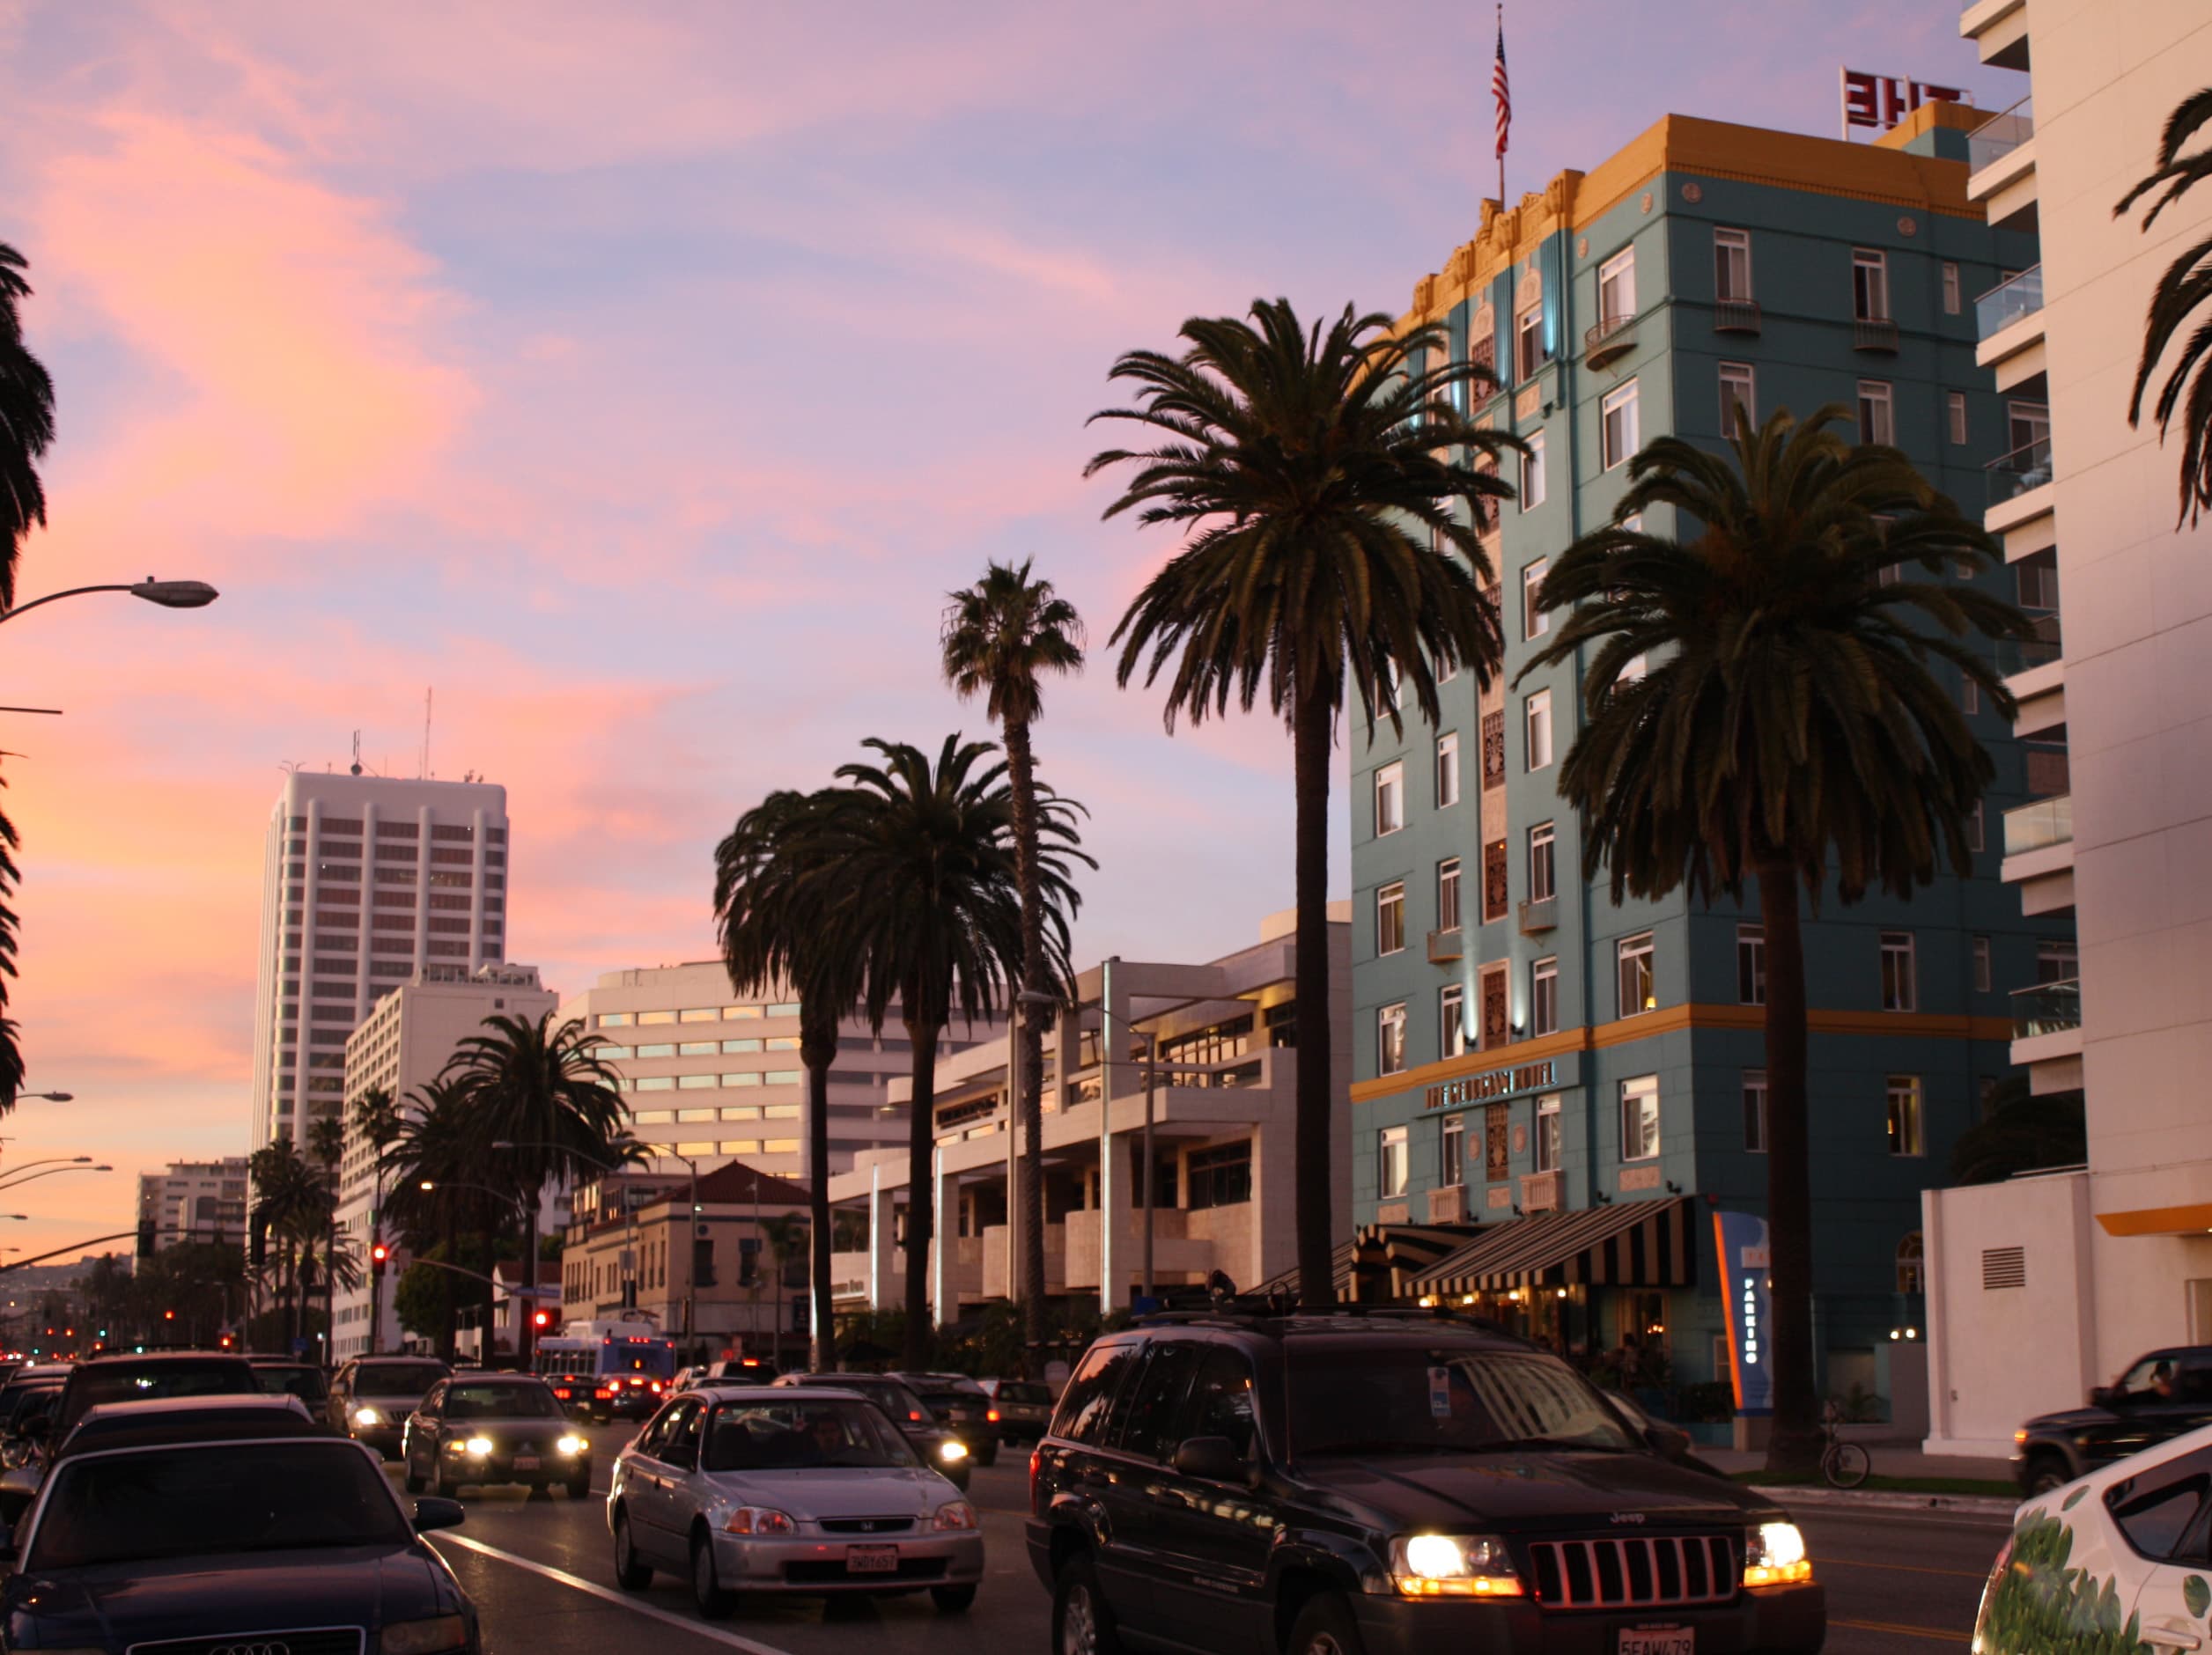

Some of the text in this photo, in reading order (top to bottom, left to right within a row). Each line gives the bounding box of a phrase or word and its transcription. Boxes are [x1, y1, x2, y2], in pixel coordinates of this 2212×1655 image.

[1515, 1062, 1557, 1092] HOTEL
[1744, 1278, 1757, 1364] PARKING
[1610, 1512, 1645, 1523] Jeep
